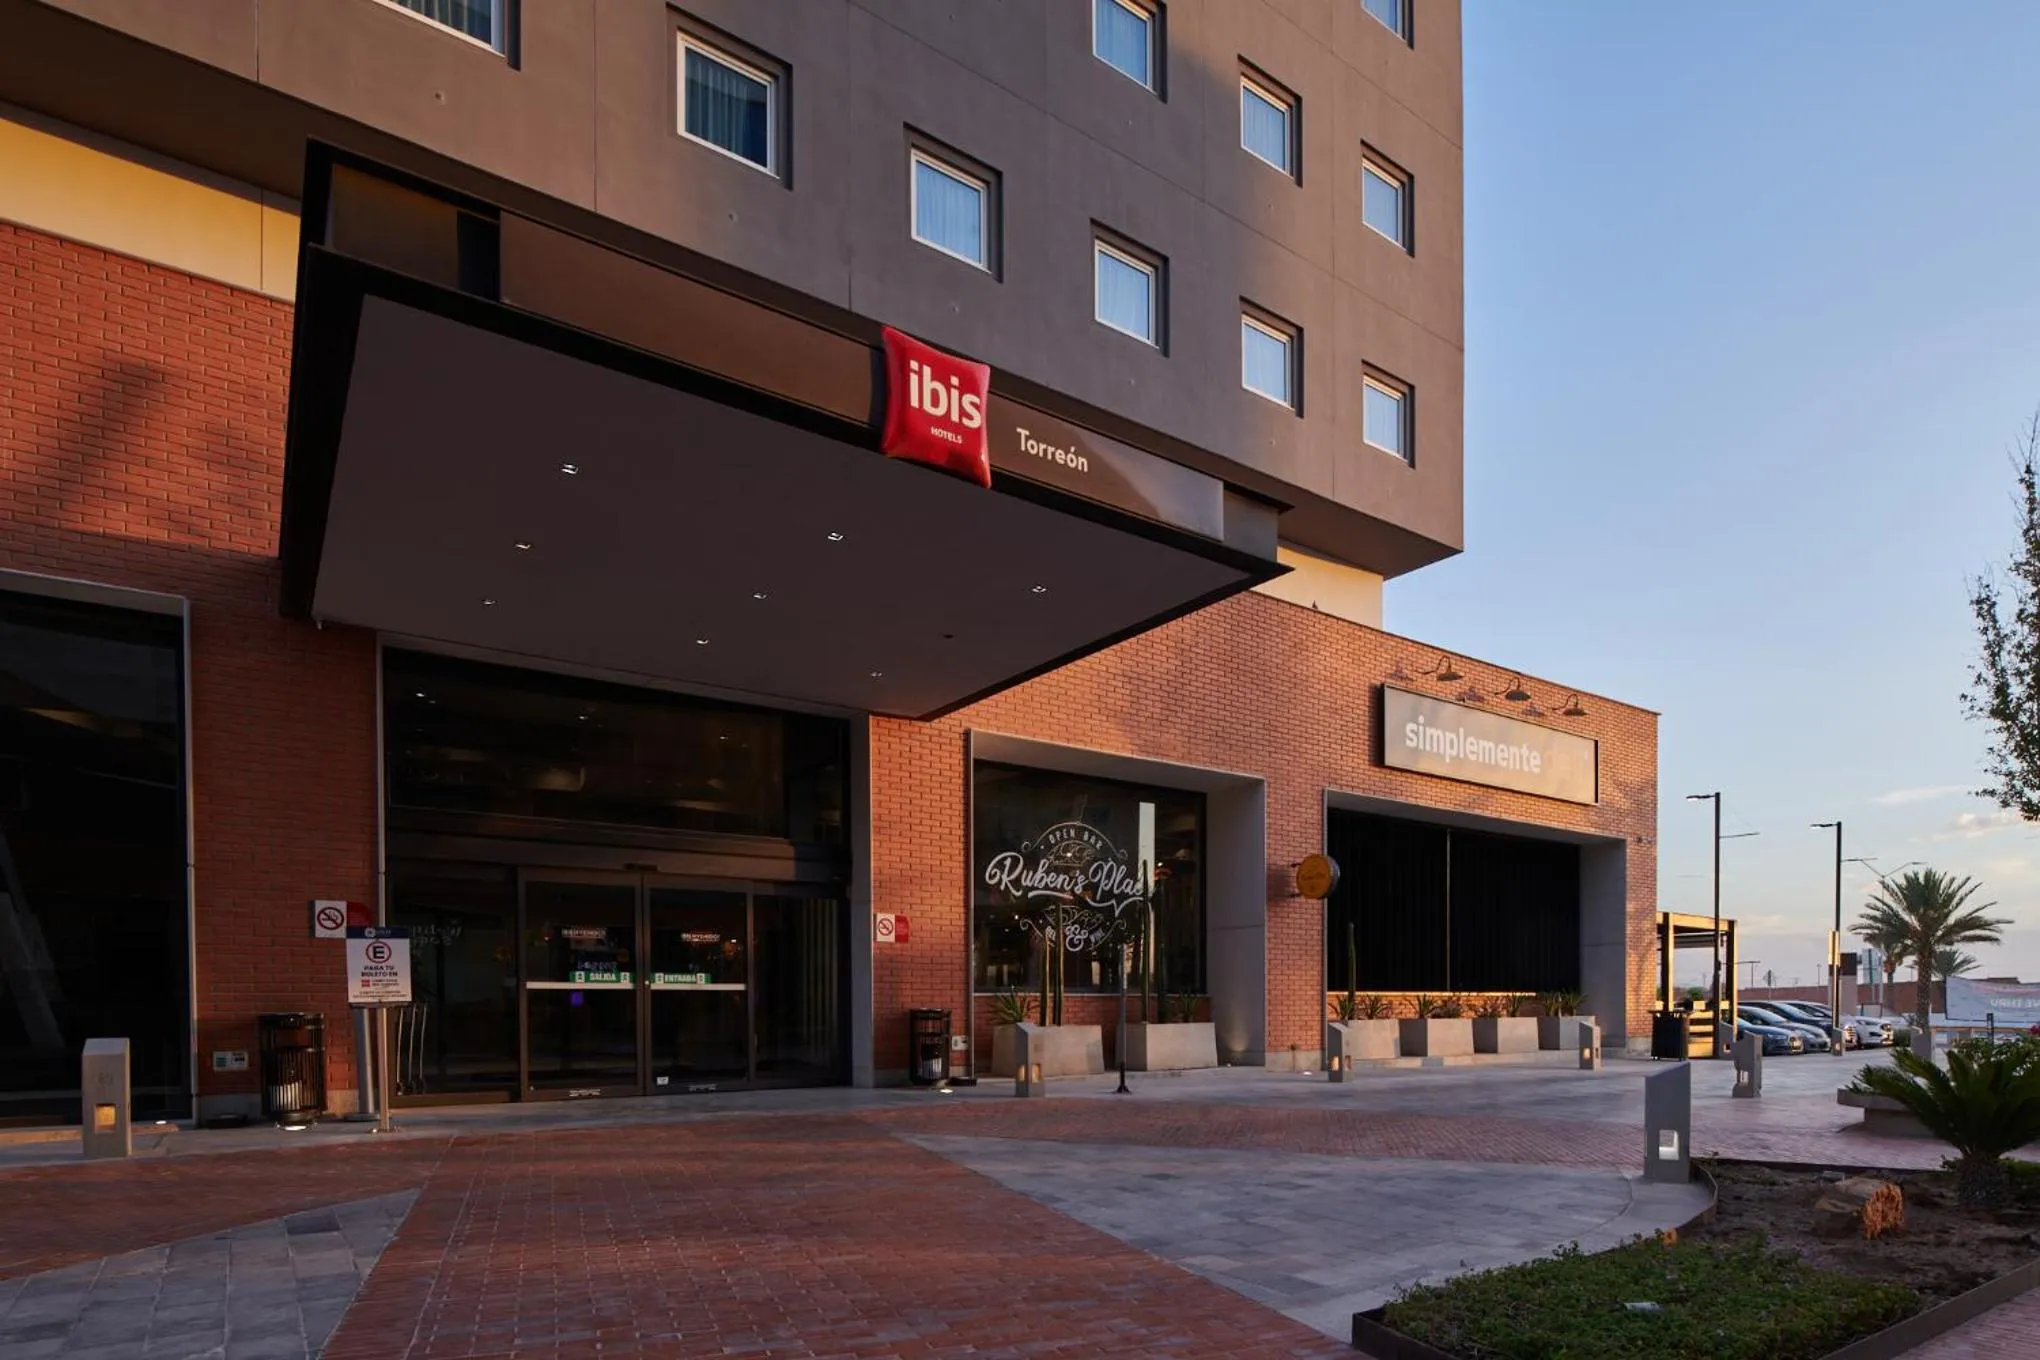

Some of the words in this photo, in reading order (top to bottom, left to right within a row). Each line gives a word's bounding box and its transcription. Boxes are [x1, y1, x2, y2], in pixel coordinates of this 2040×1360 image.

[909, 359, 982, 429] ibis
[930, 426, 962, 445] HOTELS
[1016, 427, 1089, 473] Torreón
[1405, 715, 1541, 774] simplemente
[1049, 828, 1076, 845] OPEN
[1083, 830, 1103, 850] BAR
[985, 852, 1087, 897] Ruben's
[373, 946, 385, 959] E
[589, 973, 616, 981] SALIDA
[664, 974, 697, 983] ENTRADA
